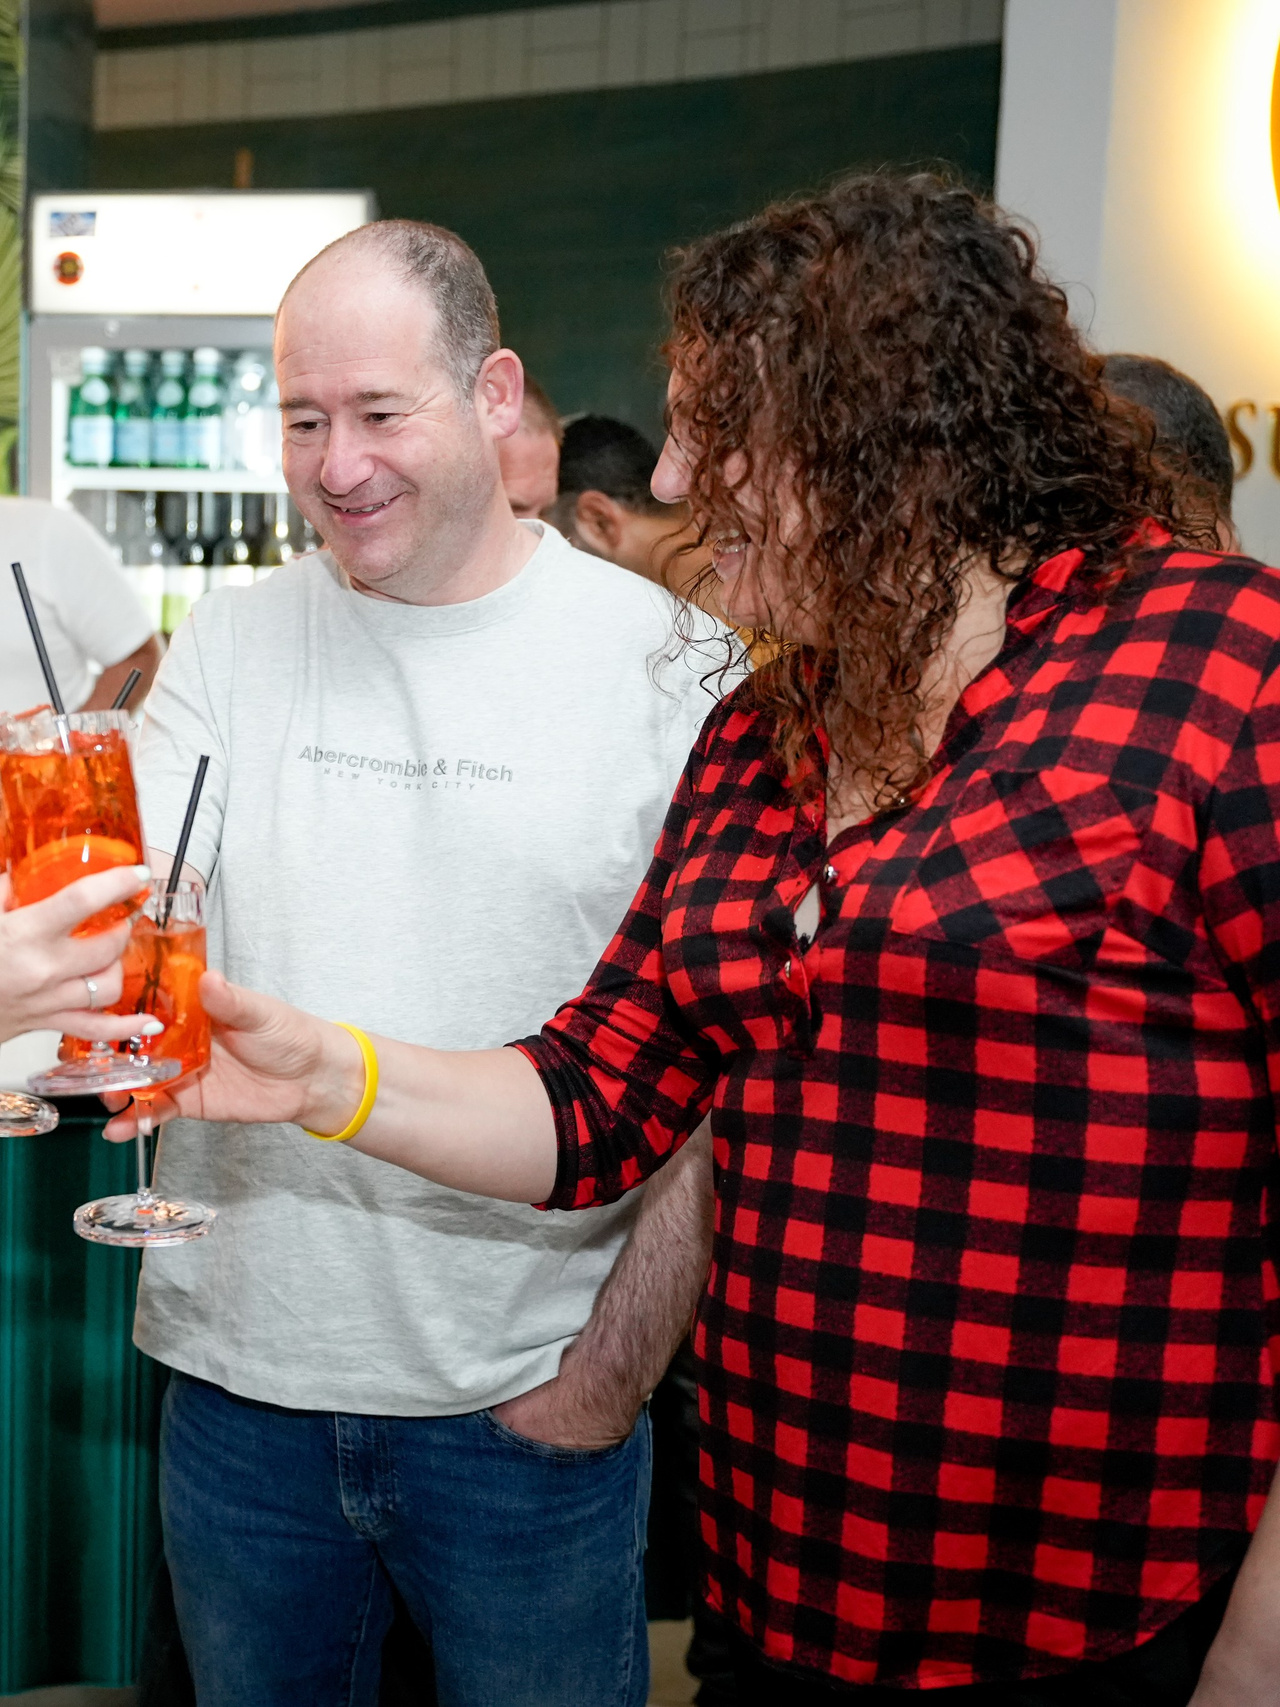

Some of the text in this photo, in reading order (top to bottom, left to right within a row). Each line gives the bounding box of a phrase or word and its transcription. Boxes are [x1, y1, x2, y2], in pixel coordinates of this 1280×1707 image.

[1225, 400, 1280, 481] S
[298, 745, 514, 782] Abercrombie & Fitch
[323, 767, 476, 791] NEW YORK CITY
